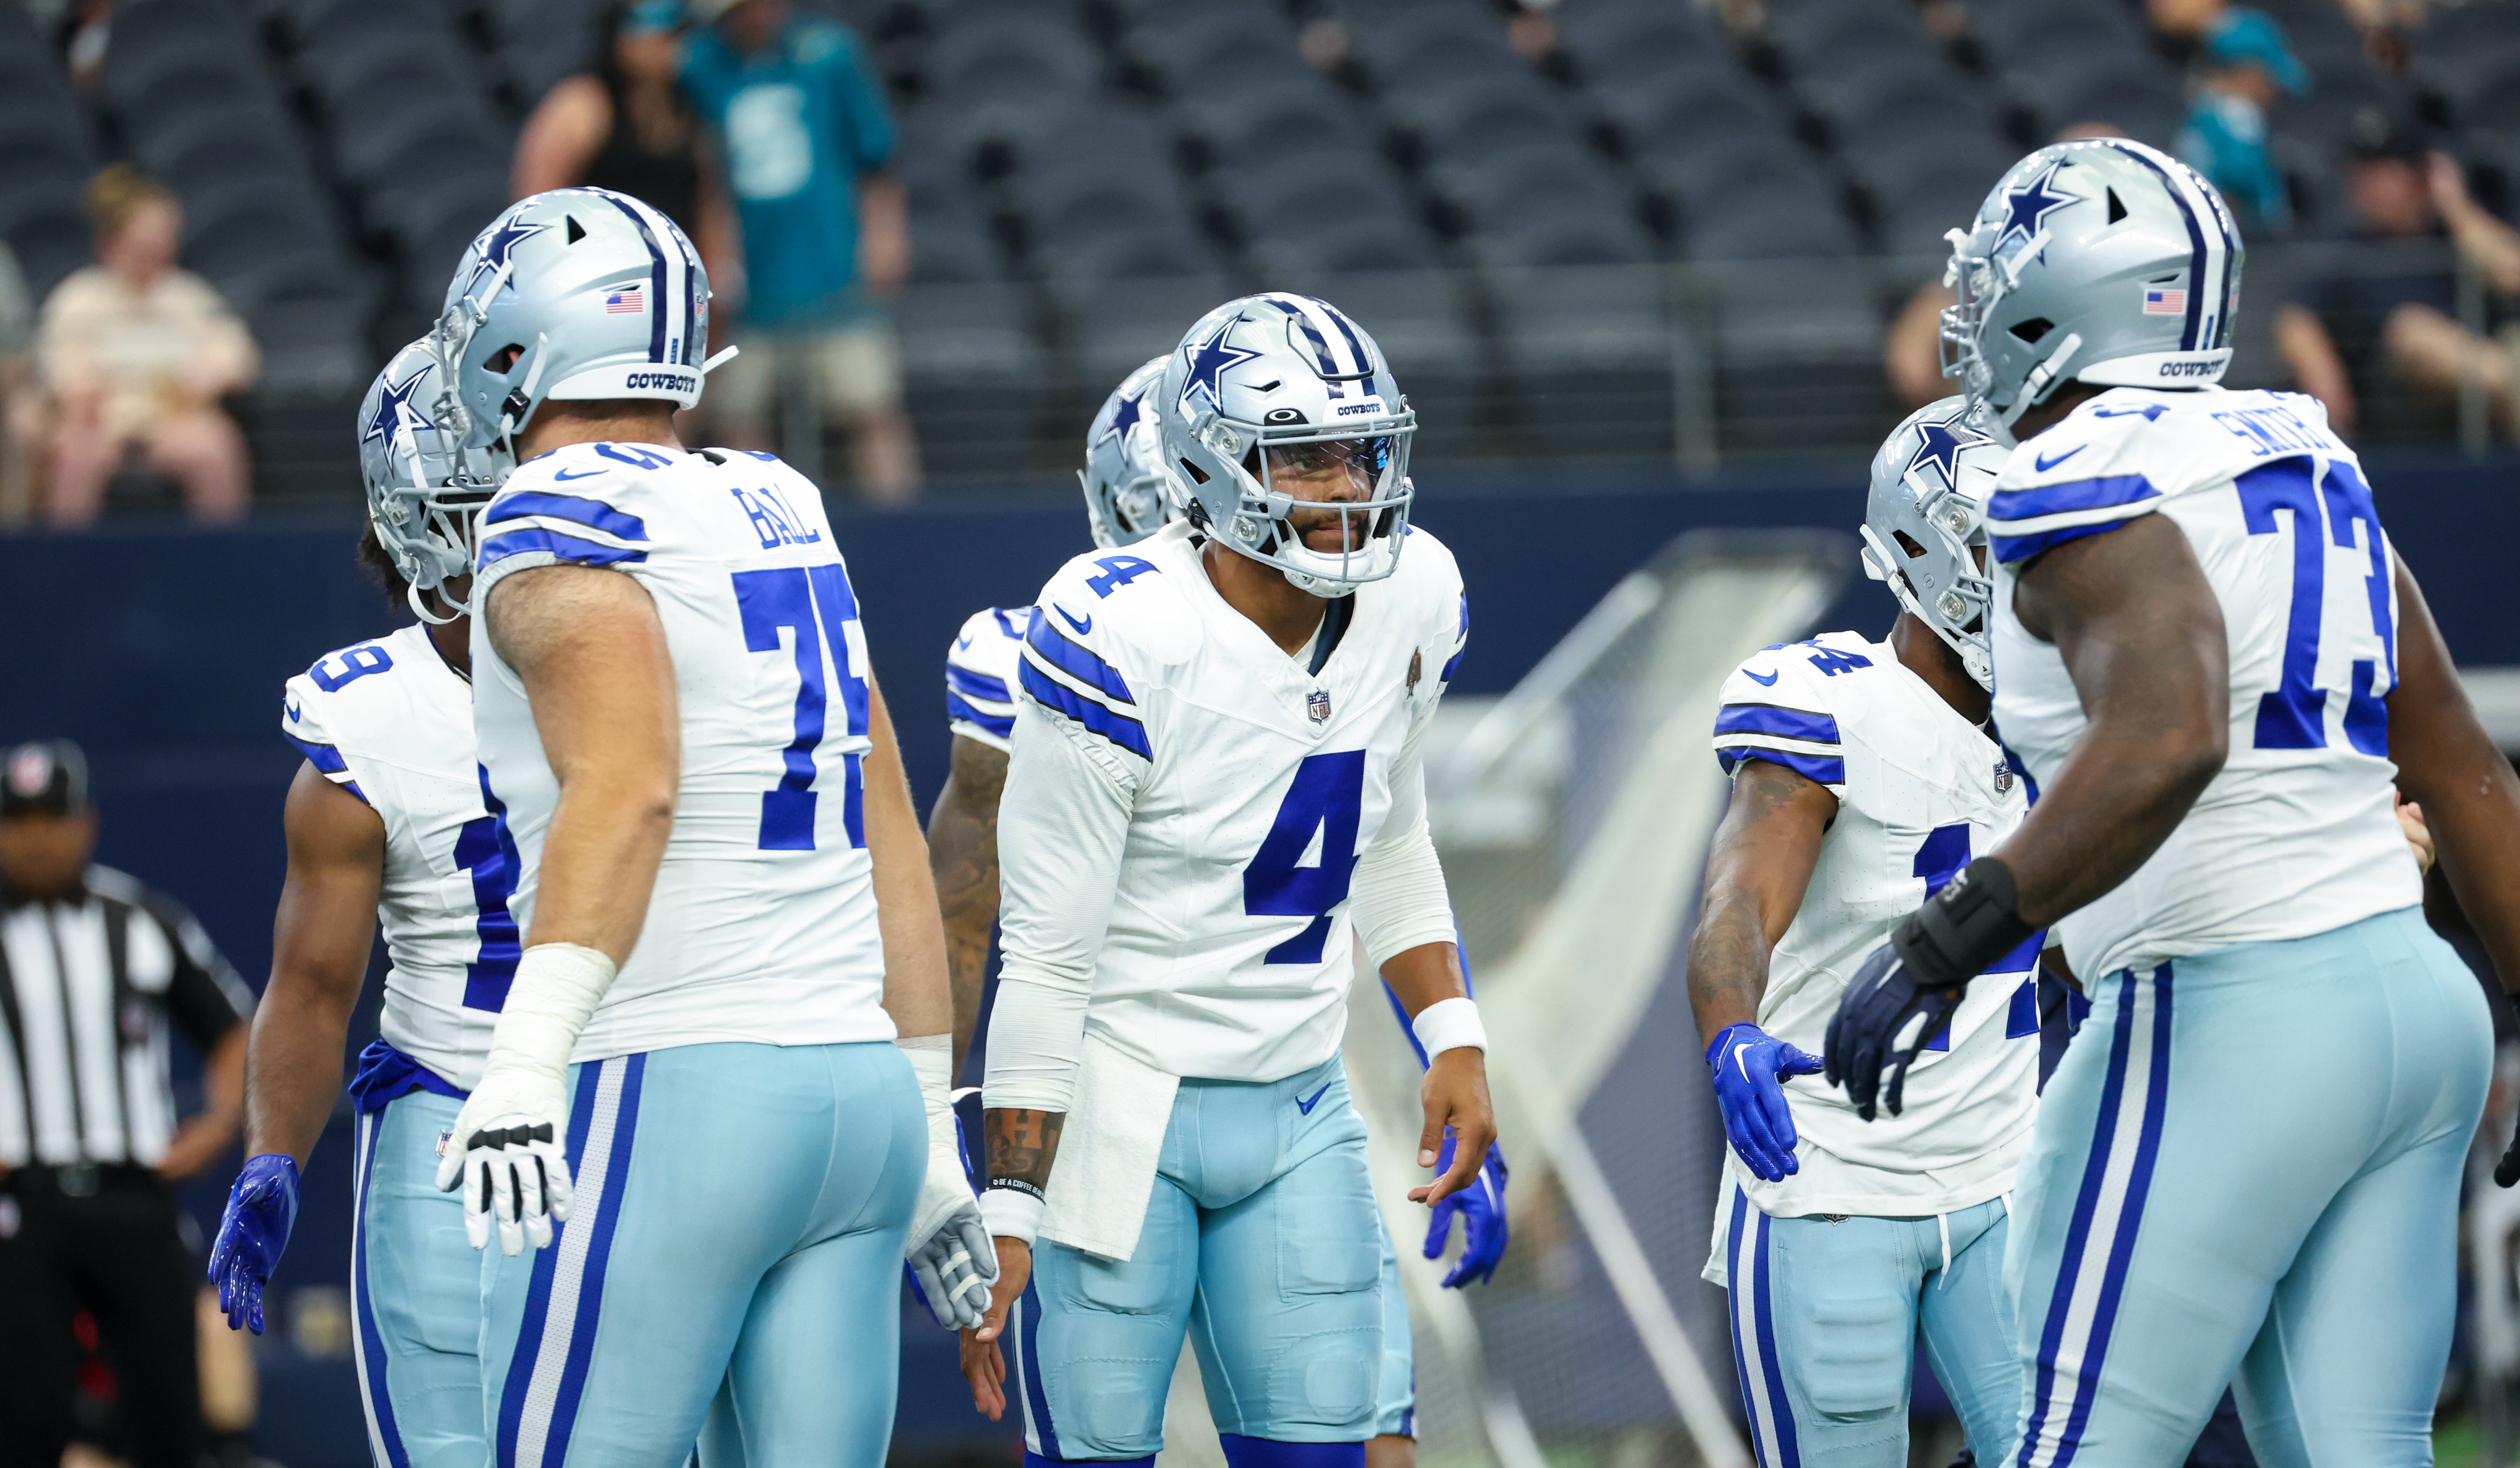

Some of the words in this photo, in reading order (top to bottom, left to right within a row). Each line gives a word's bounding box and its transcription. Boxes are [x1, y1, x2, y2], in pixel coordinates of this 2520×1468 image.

[627, 373, 696, 393] COWBOYS
[1338, 403, 1380, 416] COWBOYS
[730, 483, 821, 550] BALL
[1084, 555, 1162, 600] 4
[2233, 453, 2399, 758] 73
[302, 638, 394, 693] 9
[1243, 748, 1366, 966] 4
[1012, 1179, 1033, 1191] COFFEE
[1032, 1186, 1042, 1197] BEAN
